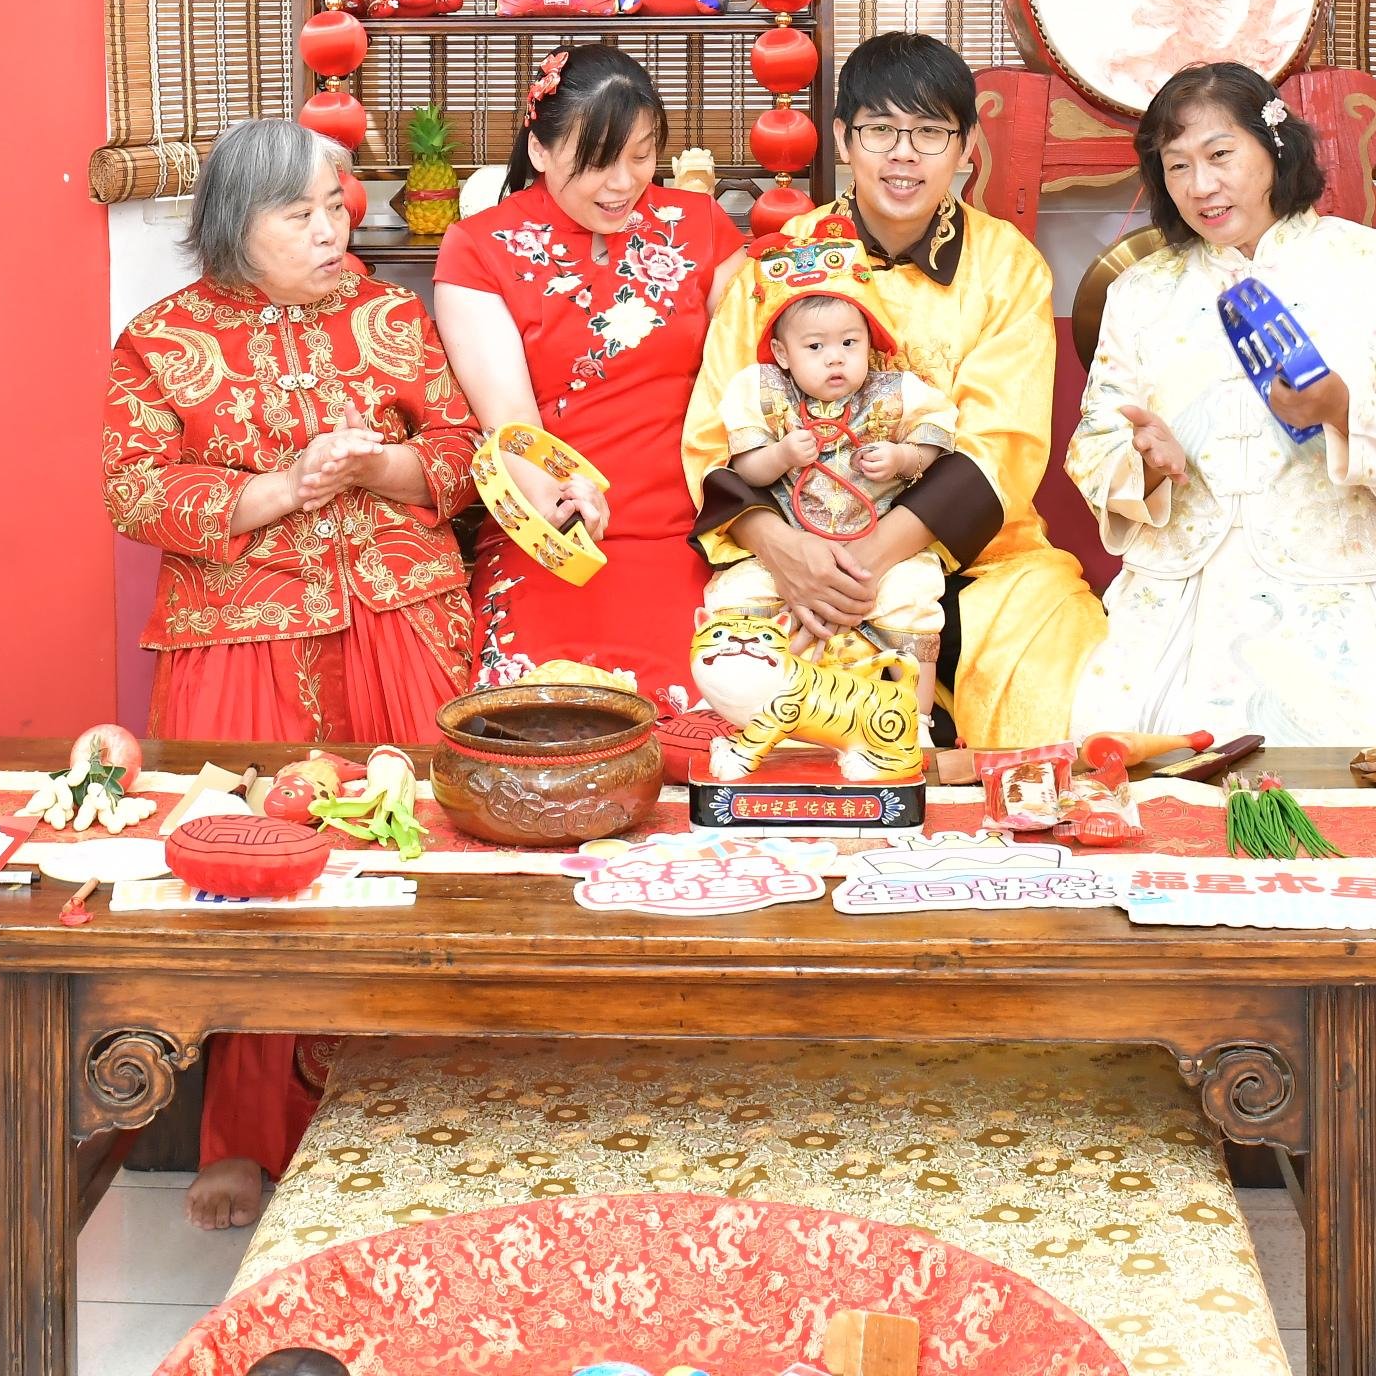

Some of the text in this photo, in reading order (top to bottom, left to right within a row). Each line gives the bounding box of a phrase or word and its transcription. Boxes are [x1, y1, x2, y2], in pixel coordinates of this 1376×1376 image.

[607, 856, 790, 881] 今天是
[848, 875, 1117, 905] 生日快樂
